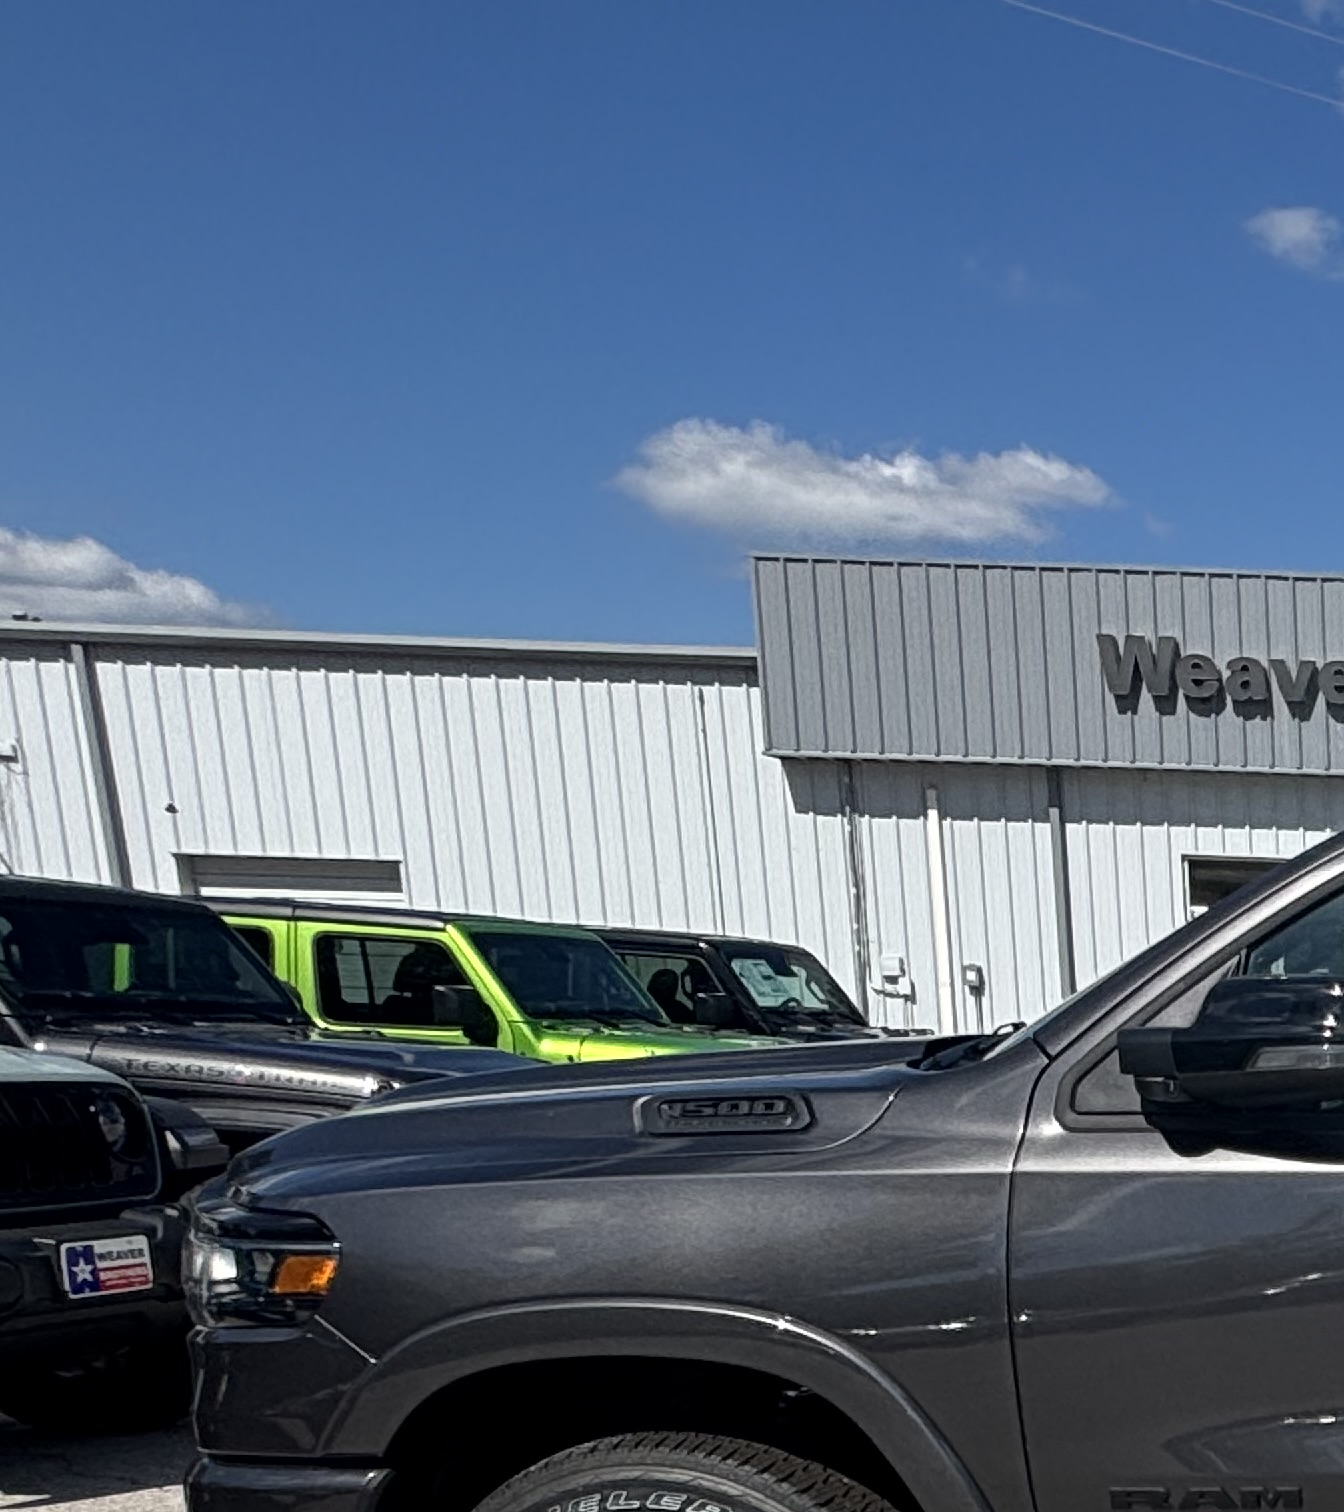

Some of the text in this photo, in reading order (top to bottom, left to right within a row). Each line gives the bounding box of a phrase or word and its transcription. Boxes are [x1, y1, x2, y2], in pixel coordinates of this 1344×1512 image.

[125, 1058, 225, 1078] TEXAS
[659, 1100, 785, 1119] 1500
[1108, 1486, 1303, 1510] RAM
